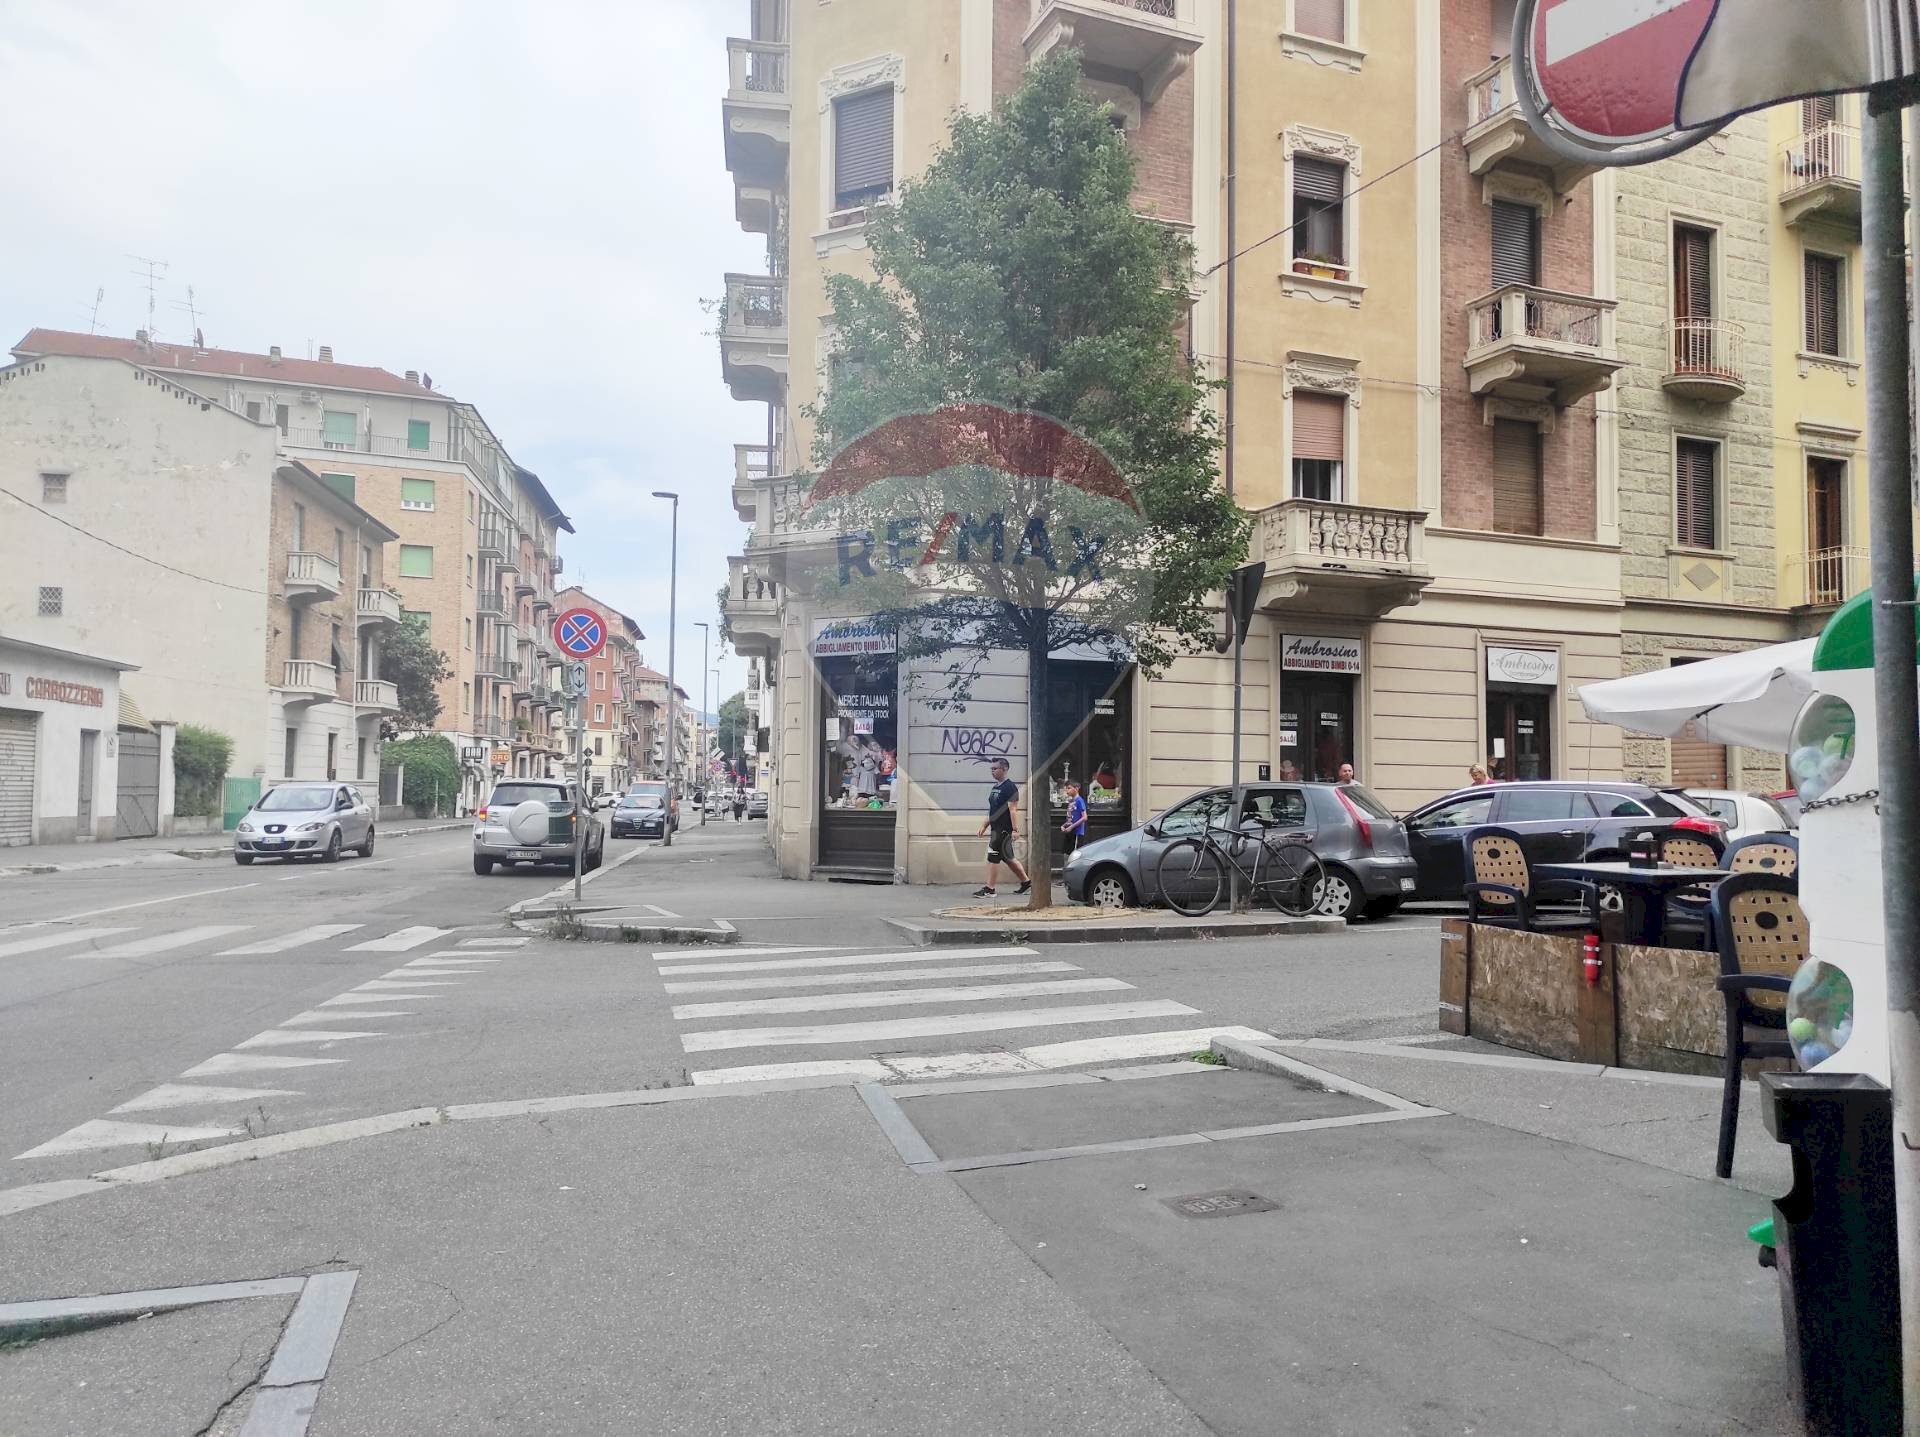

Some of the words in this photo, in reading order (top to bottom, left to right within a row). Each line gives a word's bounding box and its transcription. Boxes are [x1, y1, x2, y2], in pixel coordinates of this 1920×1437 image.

[816, 641, 862, 653] ABBIGLIAMENTO
[864, 640, 881, 651] BIMBI
[1286, 639, 1358, 658] Ambrosino
[1284, 657, 1329, 669] ABBIGLIAMENTO
[1331, 660, 1347, 670] BIMBI
[1348, 661, 1360, 671] 0-14
[1491, 654, 1556, 673] Ambrosino
[838, 694, 859, 707] MERCE
[860, 694, 889, 707] ITALIANA
[875, 709, 890, 719] STOCK
